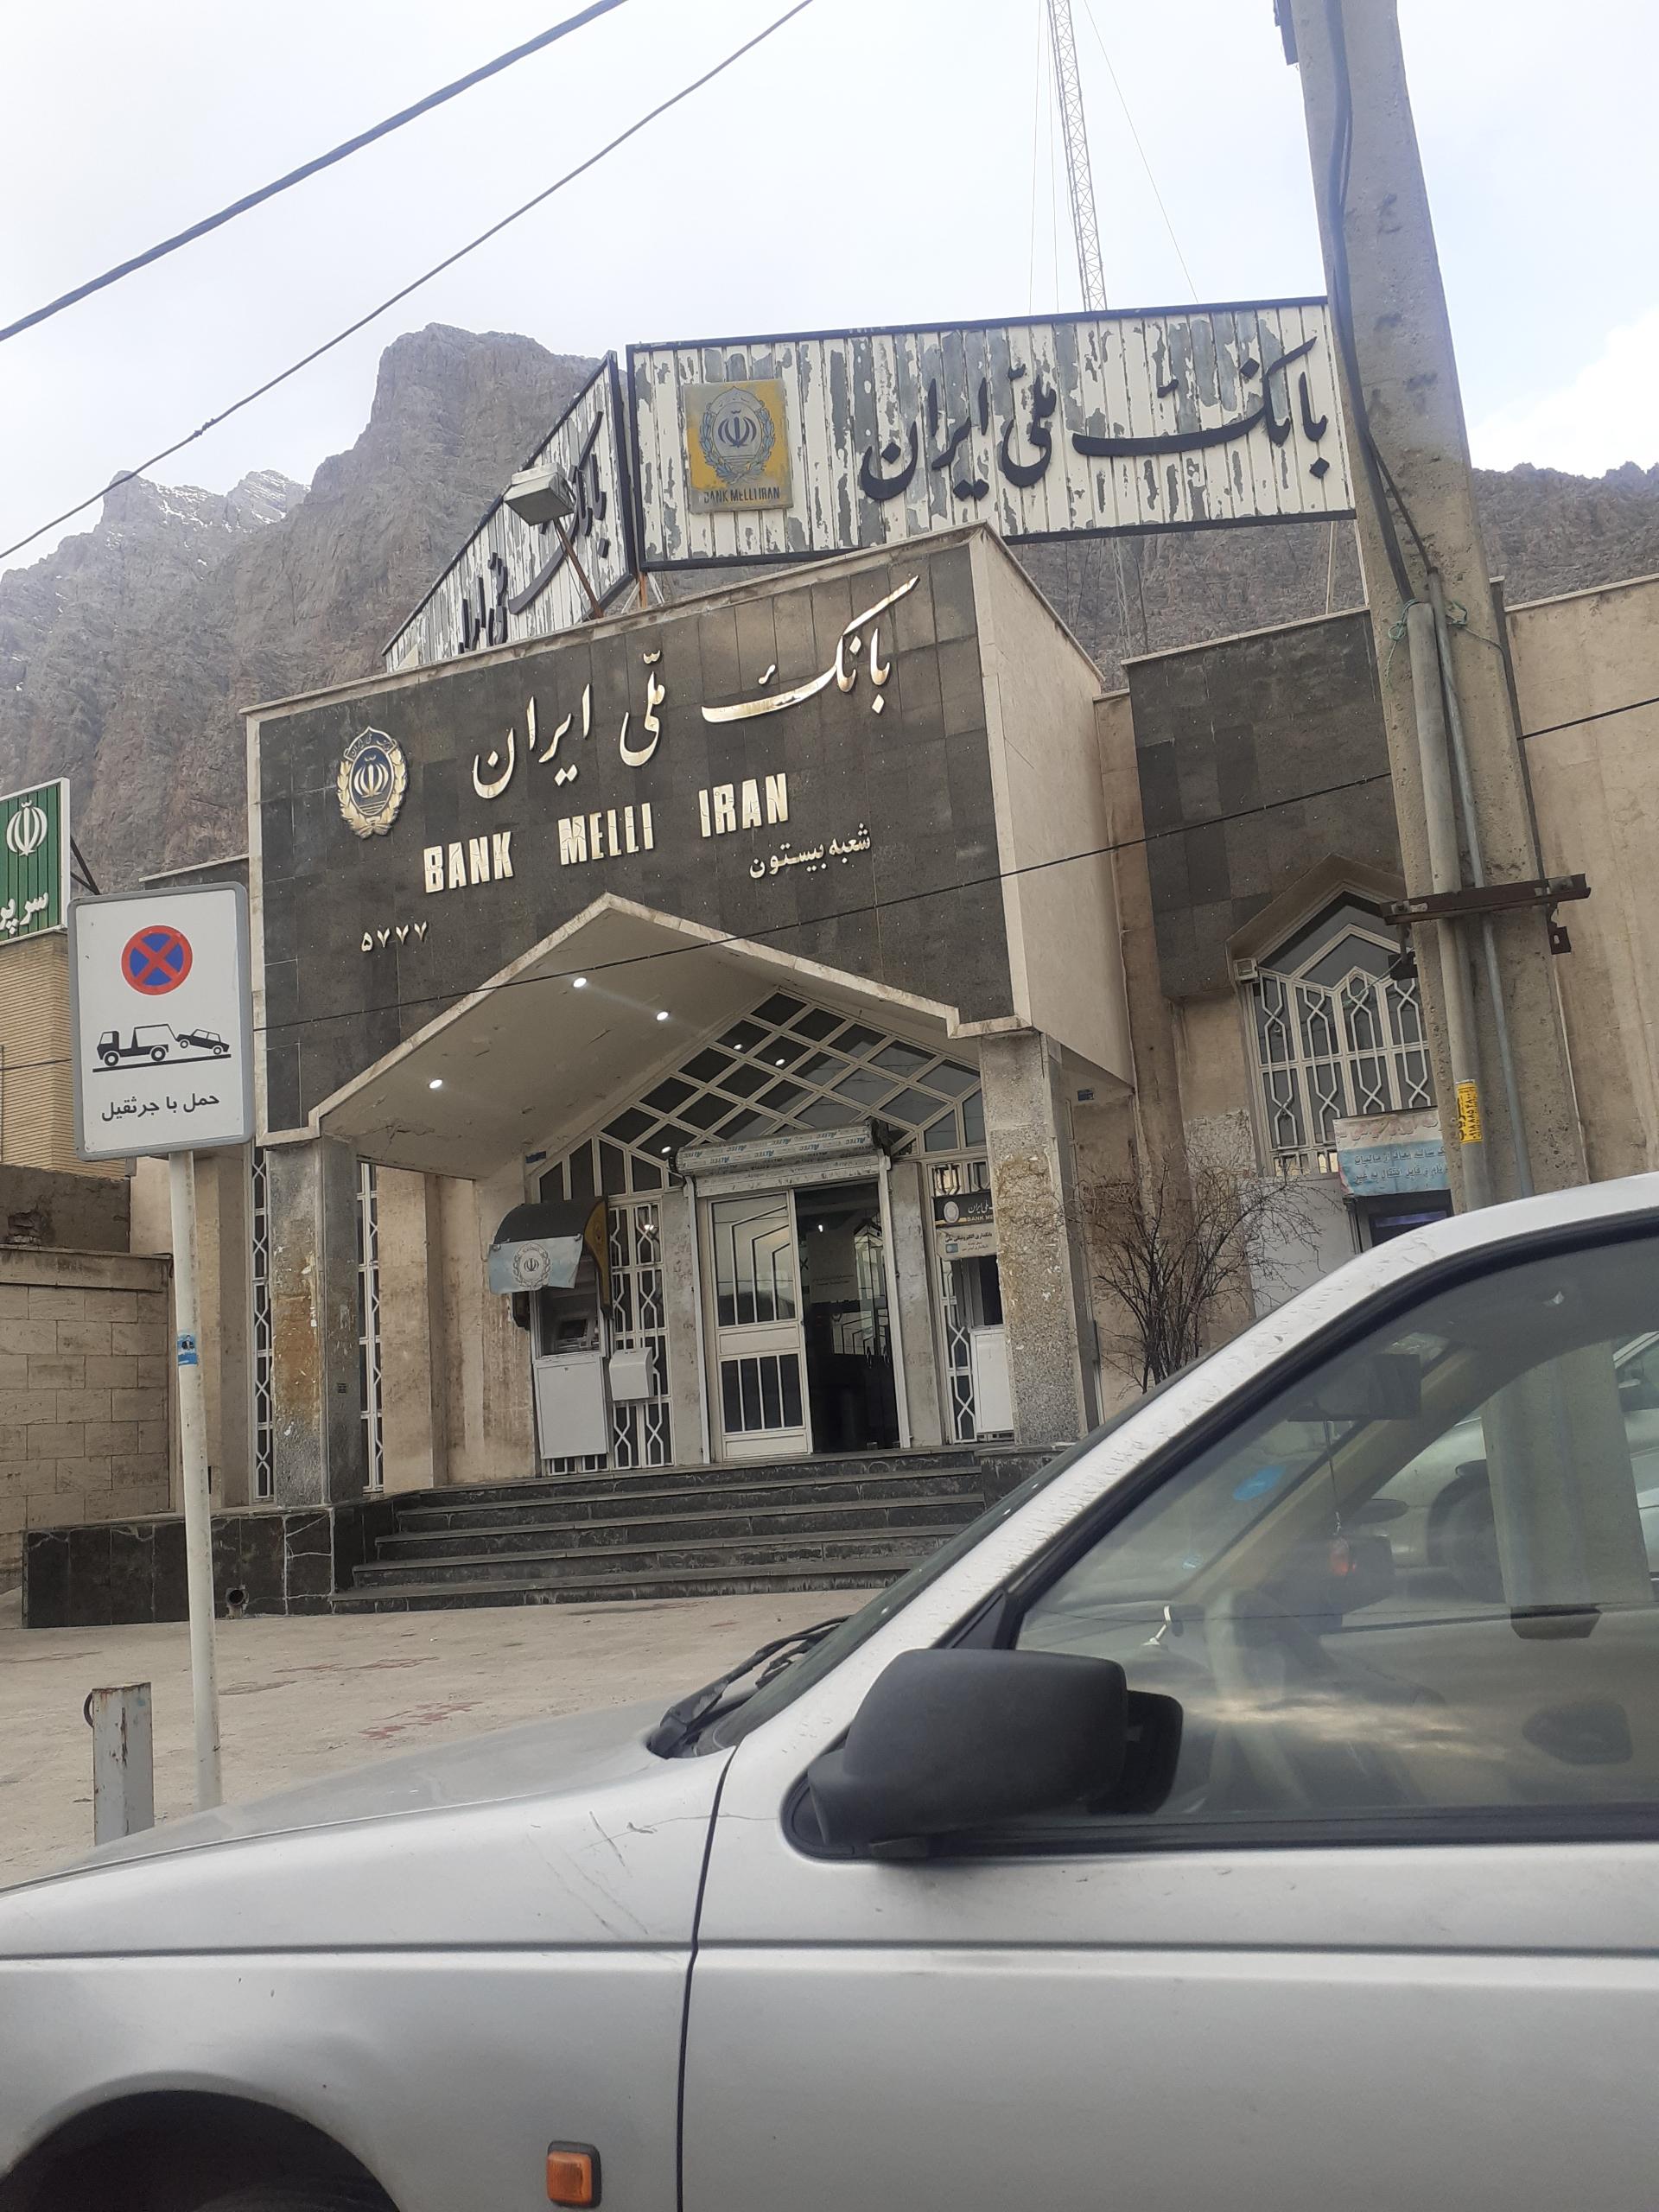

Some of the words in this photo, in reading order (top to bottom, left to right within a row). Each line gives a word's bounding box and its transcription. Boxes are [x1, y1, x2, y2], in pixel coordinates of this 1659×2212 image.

[1071, 336, 1328, 479] بانک
[863, 377, 989, 502] ایران
[757, 486, 781, 501] IRAN
[701, 574, 918, 723] بانک
[473, 682, 594, 799] ایران
[423, 830, 514, 893] BANK
[557, 802, 654, 866] MELLI
[698, 772, 789, 838] IRAN
[829, 823, 871, 864] شعبه
[749, 842, 827, 879] بیستون
[361, 920, 428, 952] ۵۷۷۷
[101, 1096, 161, 1122] جرثقیل
[166, 1096, 178, 1114] با
[183, 1092, 220, 1113] حمل
